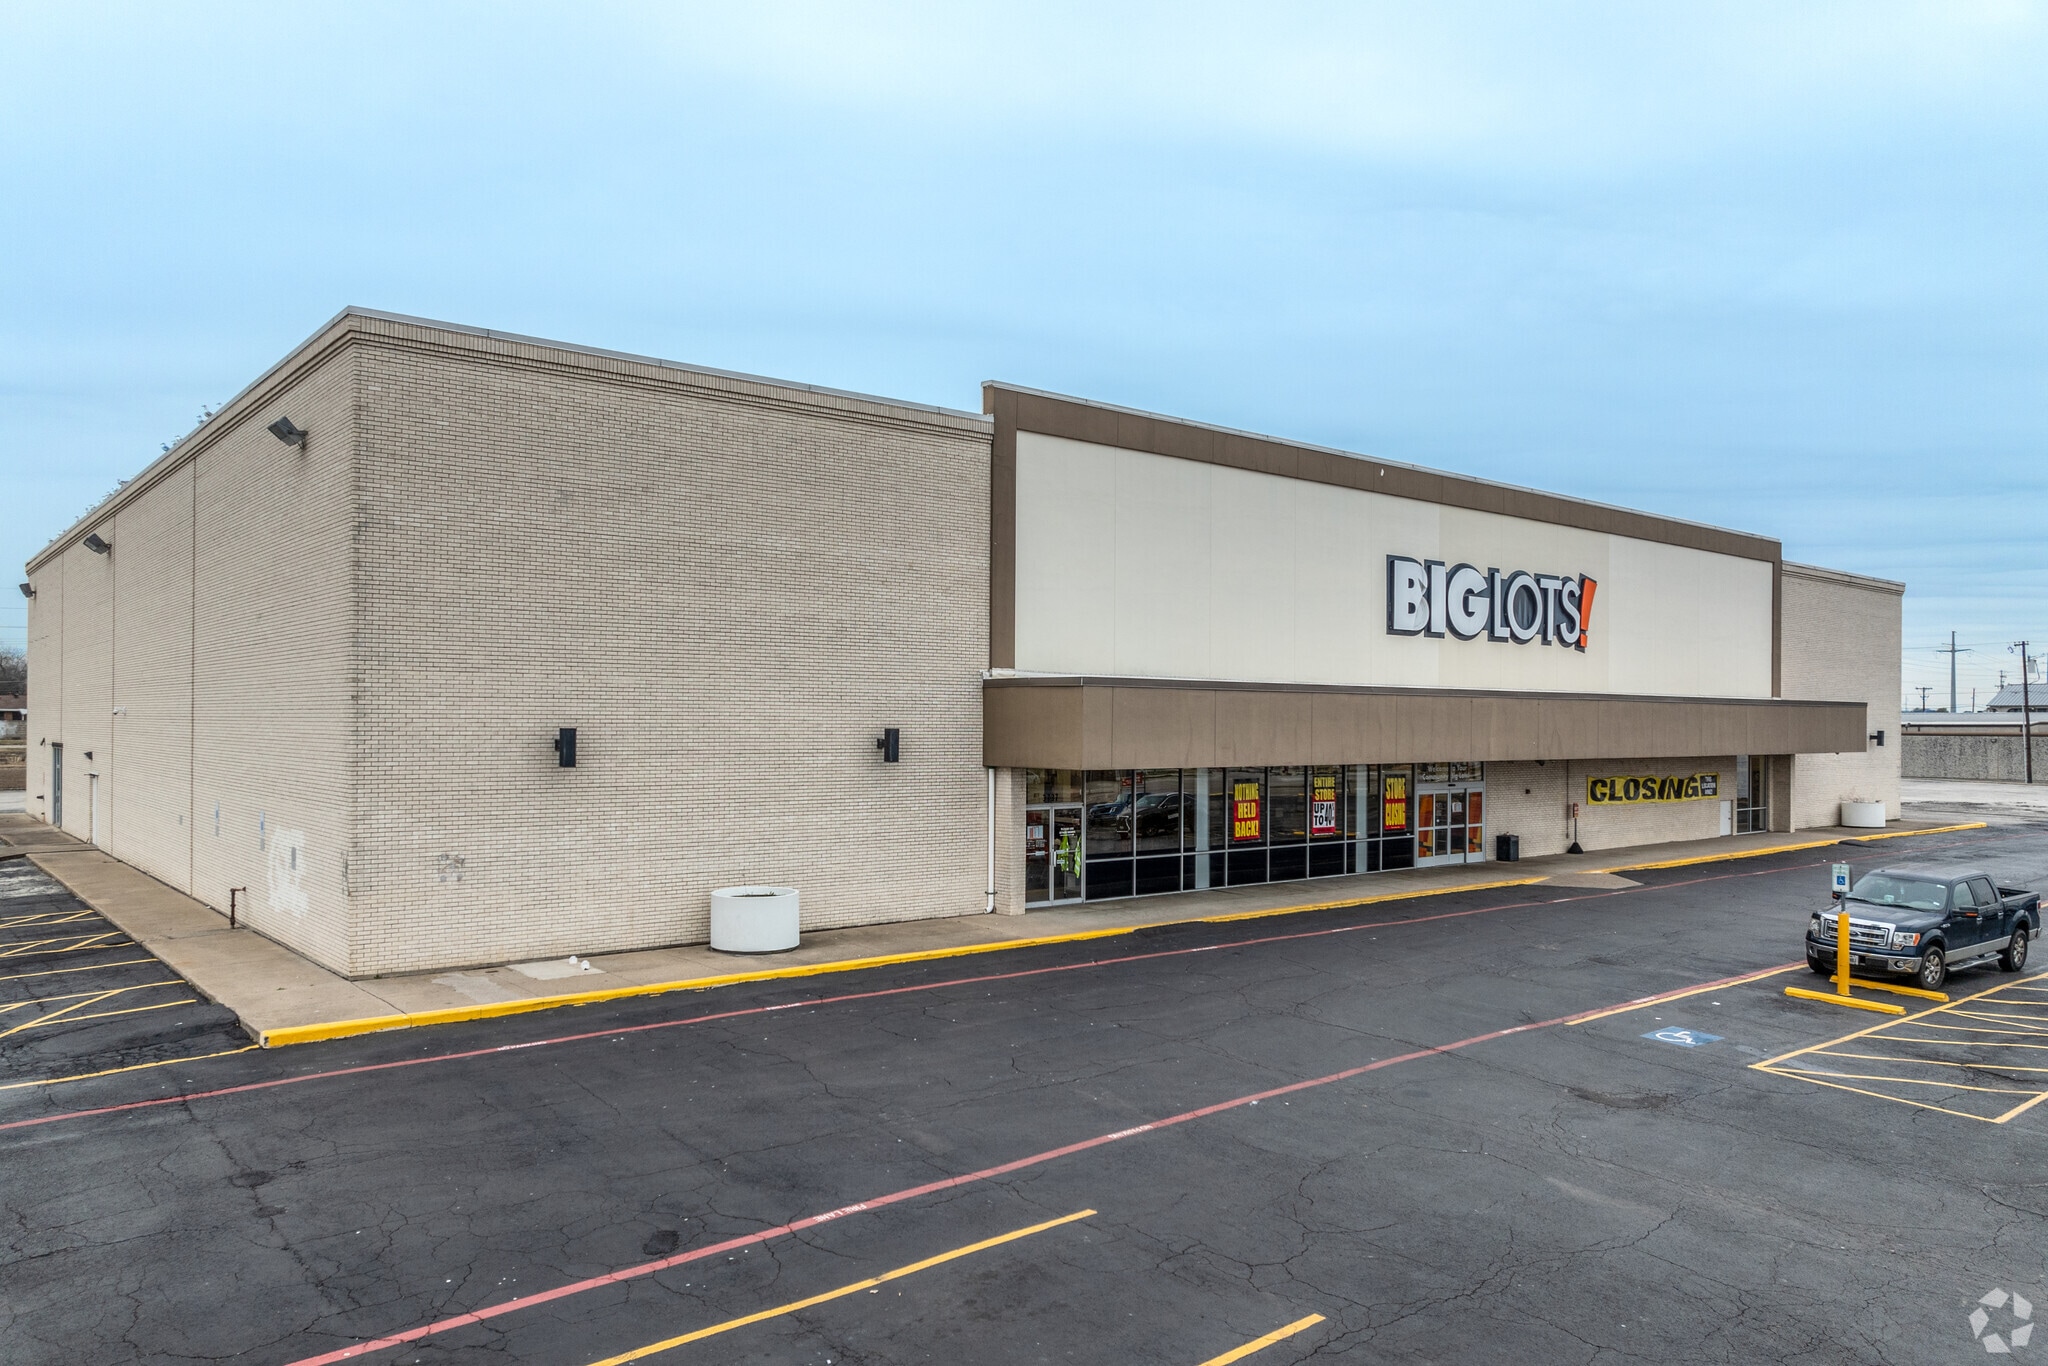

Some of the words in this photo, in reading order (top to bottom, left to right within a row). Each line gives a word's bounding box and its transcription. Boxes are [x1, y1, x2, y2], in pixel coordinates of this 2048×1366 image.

[1314, 776, 1335, 788] ENTIRE
[1386, 777, 1405, 800] STORE
[1590, 777, 1699, 801] CLOSING
[1234, 783, 1259, 801] NOTHING
[1314, 788, 1335, 801] STORE
[1237, 802, 1257, 819] HELD
[1314, 803, 1325, 814] UP
[1386, 802, 1405, 826] CLOSING
[1235, 820, 1259, 838] BACK!
[1314, 815, 1324, 826] TO
